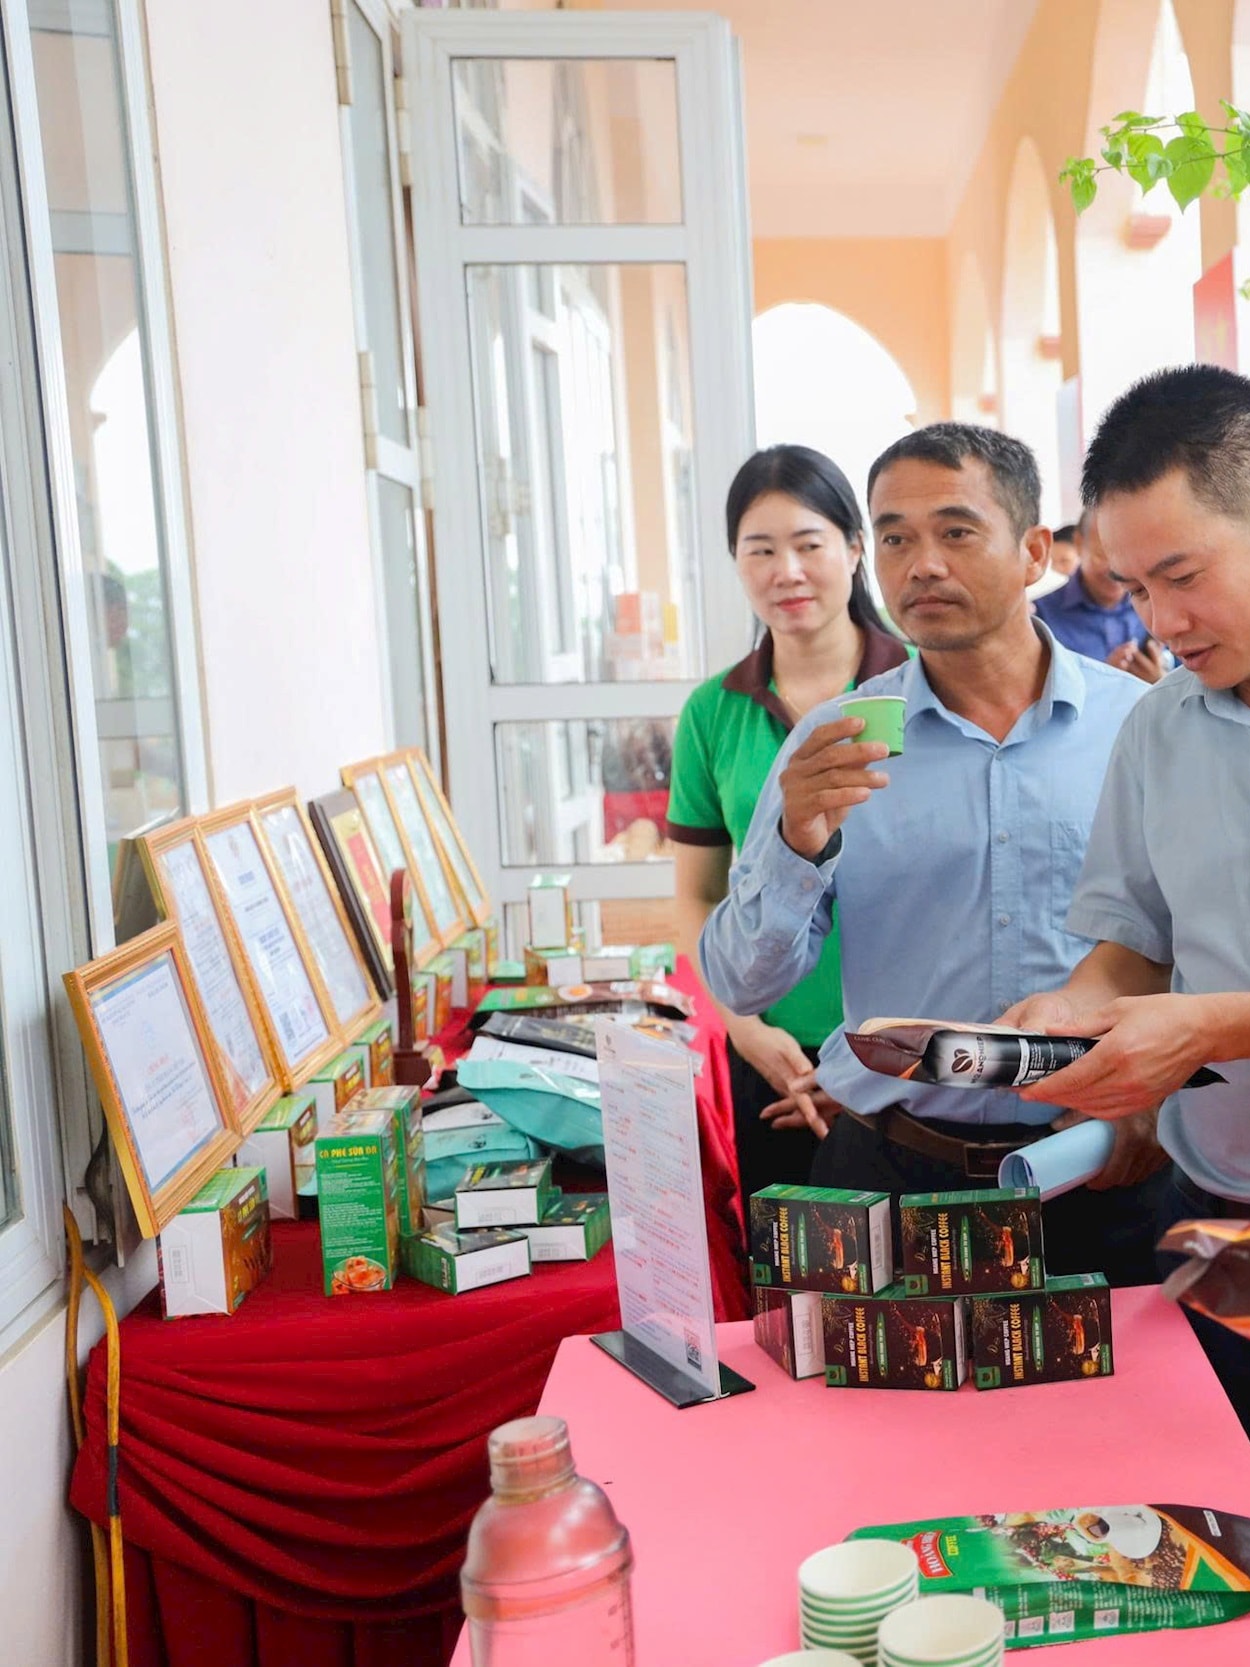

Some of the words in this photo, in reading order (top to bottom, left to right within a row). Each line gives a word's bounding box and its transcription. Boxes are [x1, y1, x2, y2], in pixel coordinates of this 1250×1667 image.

[779, 1207, 788, 1232] COFFEE
[938, 1213, 949, 1238] COFFEE
[940, 1240, 950, 1260] BLACK
[941, 1262, 952, 1288] INSTANT
[855, 1307, 866, 1332] COFFEE
[1010, 1304, 1021, 1329] COFFEE
[856, 1334, 867, 1354] BLACK
[1011, 1330, 1023, 1351] BLACK
[858, 1355, 869, 1382] INSTANT
[1013, 1352, 1024, 1379] INSTANT
